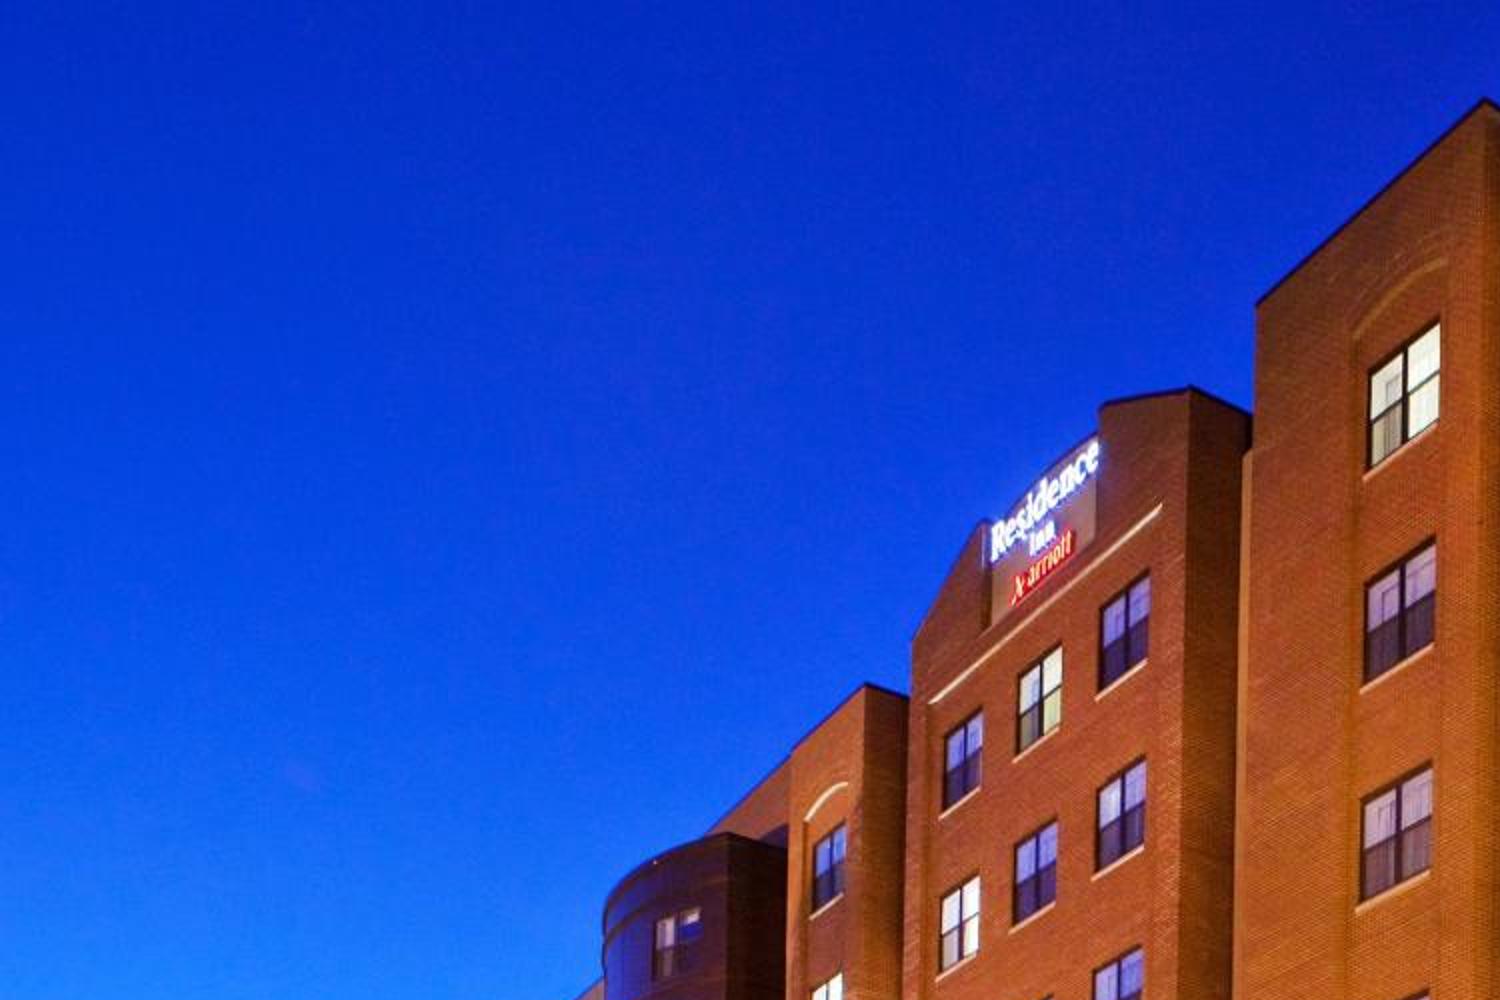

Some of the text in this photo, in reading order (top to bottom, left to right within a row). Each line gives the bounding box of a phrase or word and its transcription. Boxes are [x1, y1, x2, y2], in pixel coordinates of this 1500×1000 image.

[990, 439, 1101, 562] Residence
[1028, 519, 1057, 557] Inn
[1009, 528, 1075, 607] Marriott
